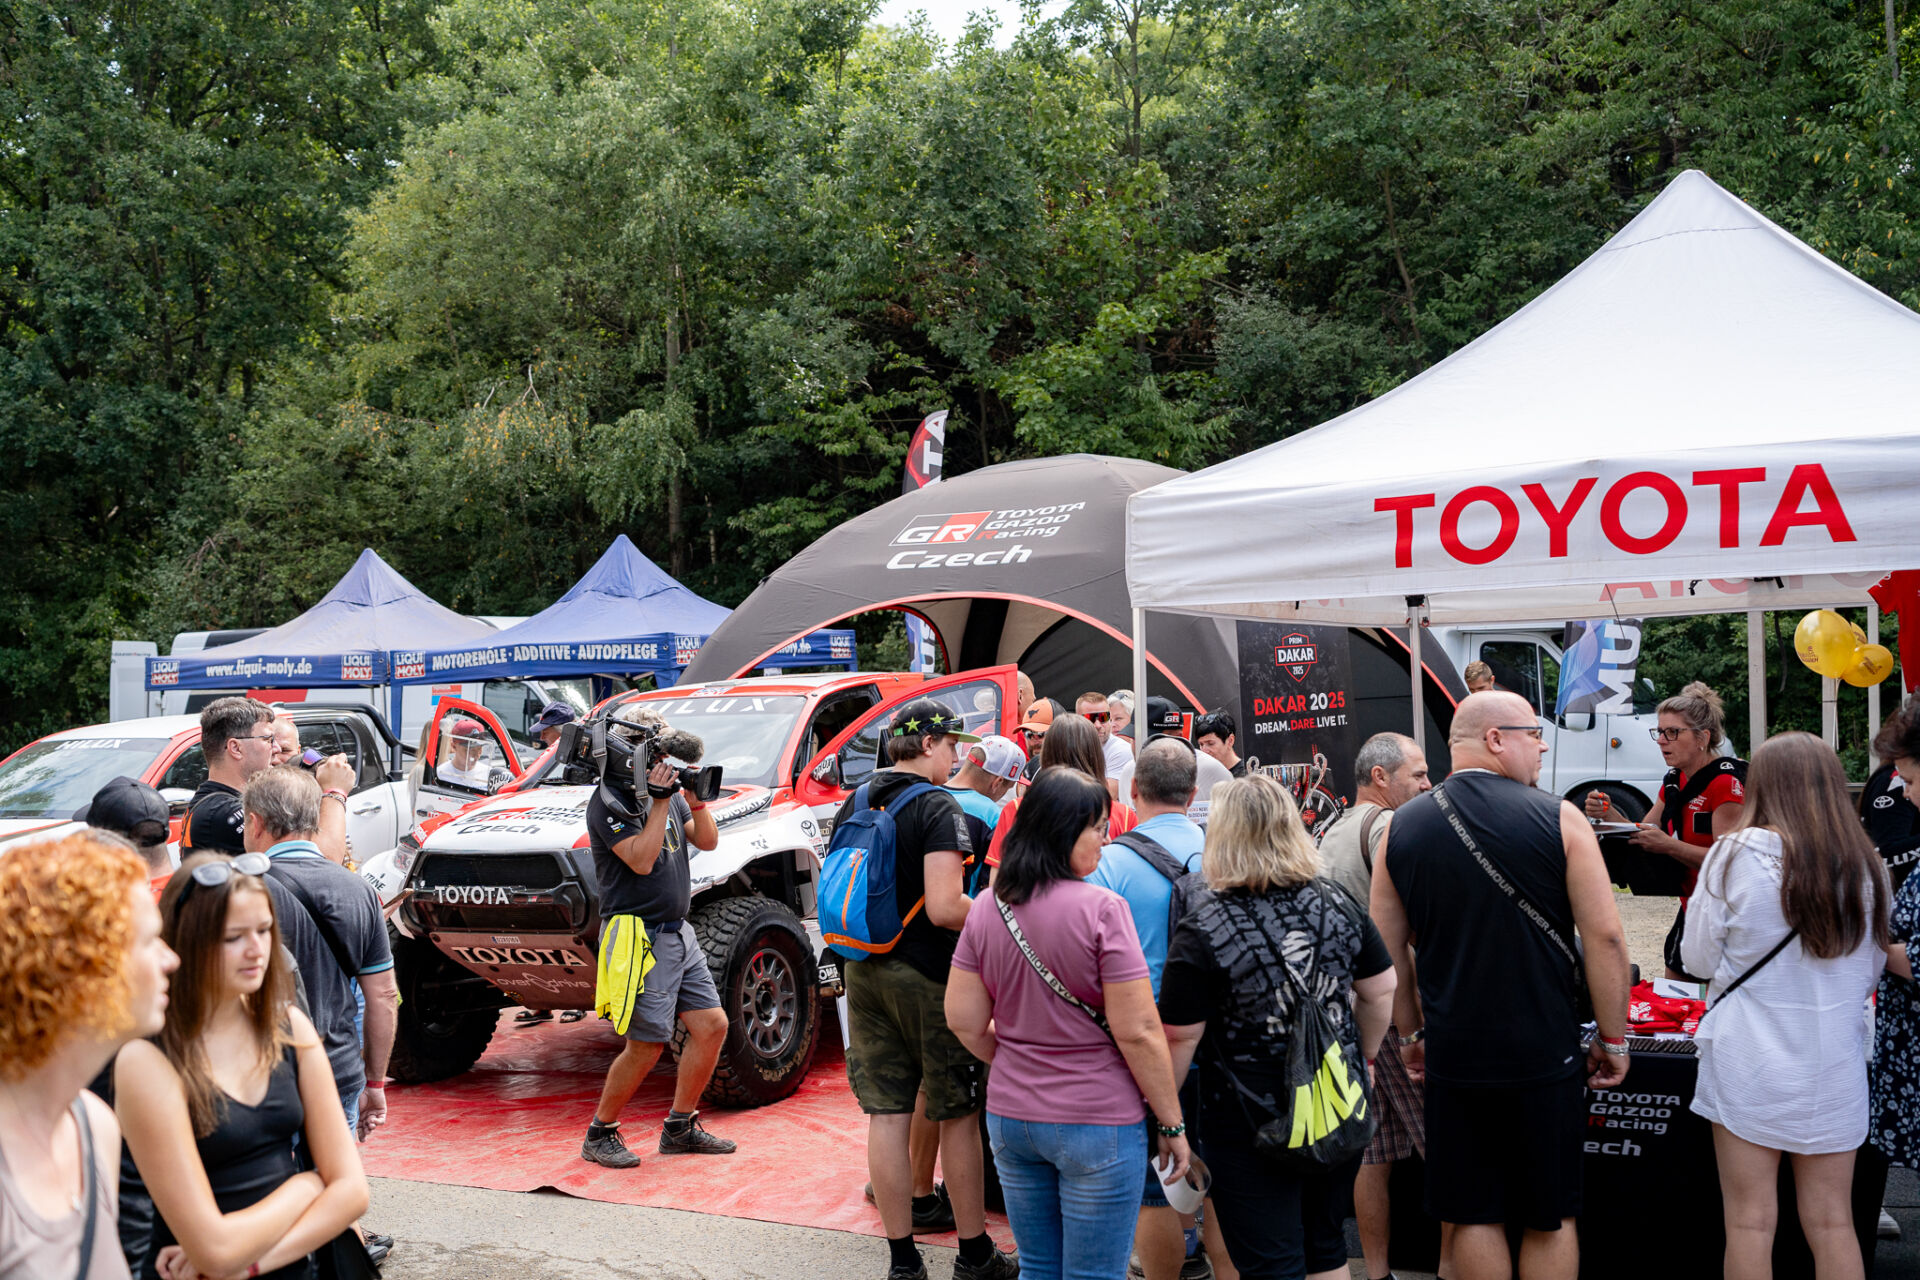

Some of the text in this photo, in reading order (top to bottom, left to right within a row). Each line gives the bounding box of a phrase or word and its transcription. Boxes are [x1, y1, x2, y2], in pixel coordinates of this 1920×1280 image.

[996, 501, 1086, 520] TOYOTA
[1374, 464, 1858, 568] TOYOTA
[984, 514, 1071, 530] GAZOO
[896, 524, 977, 544] GR
[975, 526, 1062, 540] Racing
[886, 544, 1033, 570] Czech
[343, 655, 371, 666] LIQUI
[396, 653, 423, 665] LIQUI
[432, 643, 658, 671] MOTORENÖLE ADDITIVE AUTOPFLEGE
[1277, 647, 1315, 663] DAKAR
[153, 662, 179, 673] LIQUI
[206, 658, 312, 678] www.liqui-moly.de
[343, 667, 372, 679] MOLY
[396, 665, 424, 677] MOLY
[1595, 618, 1642, 715] MU
[1254, 691, 1346, 716] DAKAR 2025
[54, 738, 132, 750] HILUX
[456, 824, 541, 835] Czech
[1447, 813, 1477, 852] UNDER
[1471, 851, 1516, 897] ARMOUR
[434, 885, 510, 905] TOYOTA
[1517, 898, 1550, 932] UNDER
[451, 946, 589, 967] TOYOTA
[1288, 1040, 1362, 1148] NIKE
[1592, 1089, 1681, 1106] TOYOTA
[1589, 1103, 1672, 1118] GAZOO
[1588, 1115, 1668, 1135] Racing
